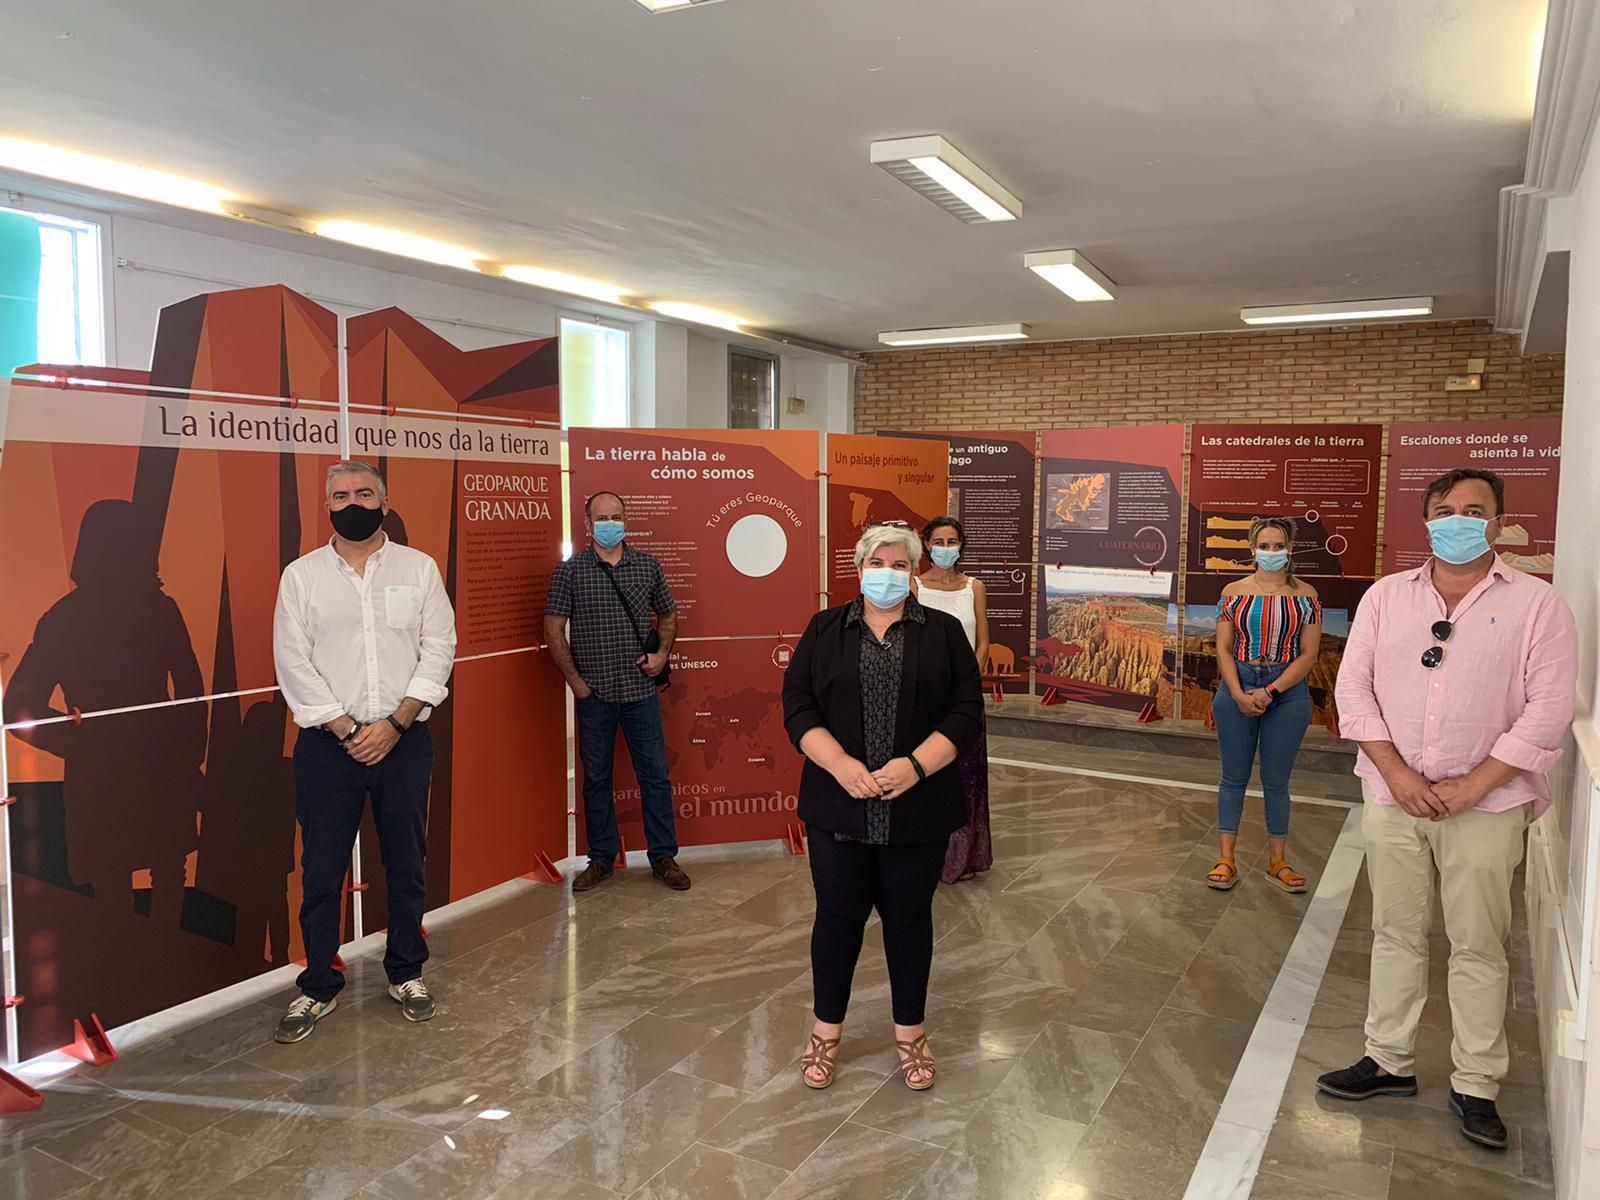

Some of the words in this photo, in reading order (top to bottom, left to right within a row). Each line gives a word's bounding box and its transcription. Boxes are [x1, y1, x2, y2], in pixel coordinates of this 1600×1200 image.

[158, 406, 198, 437] La
[209, 411, 339, 445] identidad
[354, 427, 397, 451] que
[403, 430, 443, 450] nos
[448, 427, 472, 452] da
[477, 429, 495, 453] la
[499, 431, 550, 456] tierra
[1201, 435, 1223, 447] Las
[1225, 435, 1291, 447] catedrales
[1294, 435, 1311, 447] de
[1314, 435, 1327, 447] la
[1329, 435, 1365, 447] tierra
[1400, 434, 1462, 446] Escalones
[1465, 433, 1509, 445] donde
[1512, 434, 1529, 444] se
[585, 446, 606, 462] La
[609, 446, 657, 462] tierra
[661, 446, 707, 462] habla
[711, 451, 727, 462] de
[967, 444, 1009, 455] antiguo
[1469, 447, 1518, 459] asienta
[1522, 446, 1535, 458] la
[1539, 446, 1561, 458] vid
[834, 451, 849, 465] Un
[850, 453, 881, 468] paisaje
[882, 454, 919, 469] primitivo
[948, 455, 973, 466] lago
[650, 465, 698, 480] cómo
[701, 467, 755, 480] somos
[897, 472, 904, 483] y
[904, 471, 935, 485] singular
[463, 473, 550, 495] GEOPARQUE
[464, 499, 552, 521] GRANADA
[706, 513, 721, 528] Tú
[719, 496, 743, 515] eres
[745, 492, 802, 528] Geoparque
[1099, 541, 1162, 551] CUATERNARIO
[681, 661, 718, 670] UNESCO
[713, 784, 726, 794] en
[679, 796, 701, 819] el
[708, 790, 799, 818] mundo
